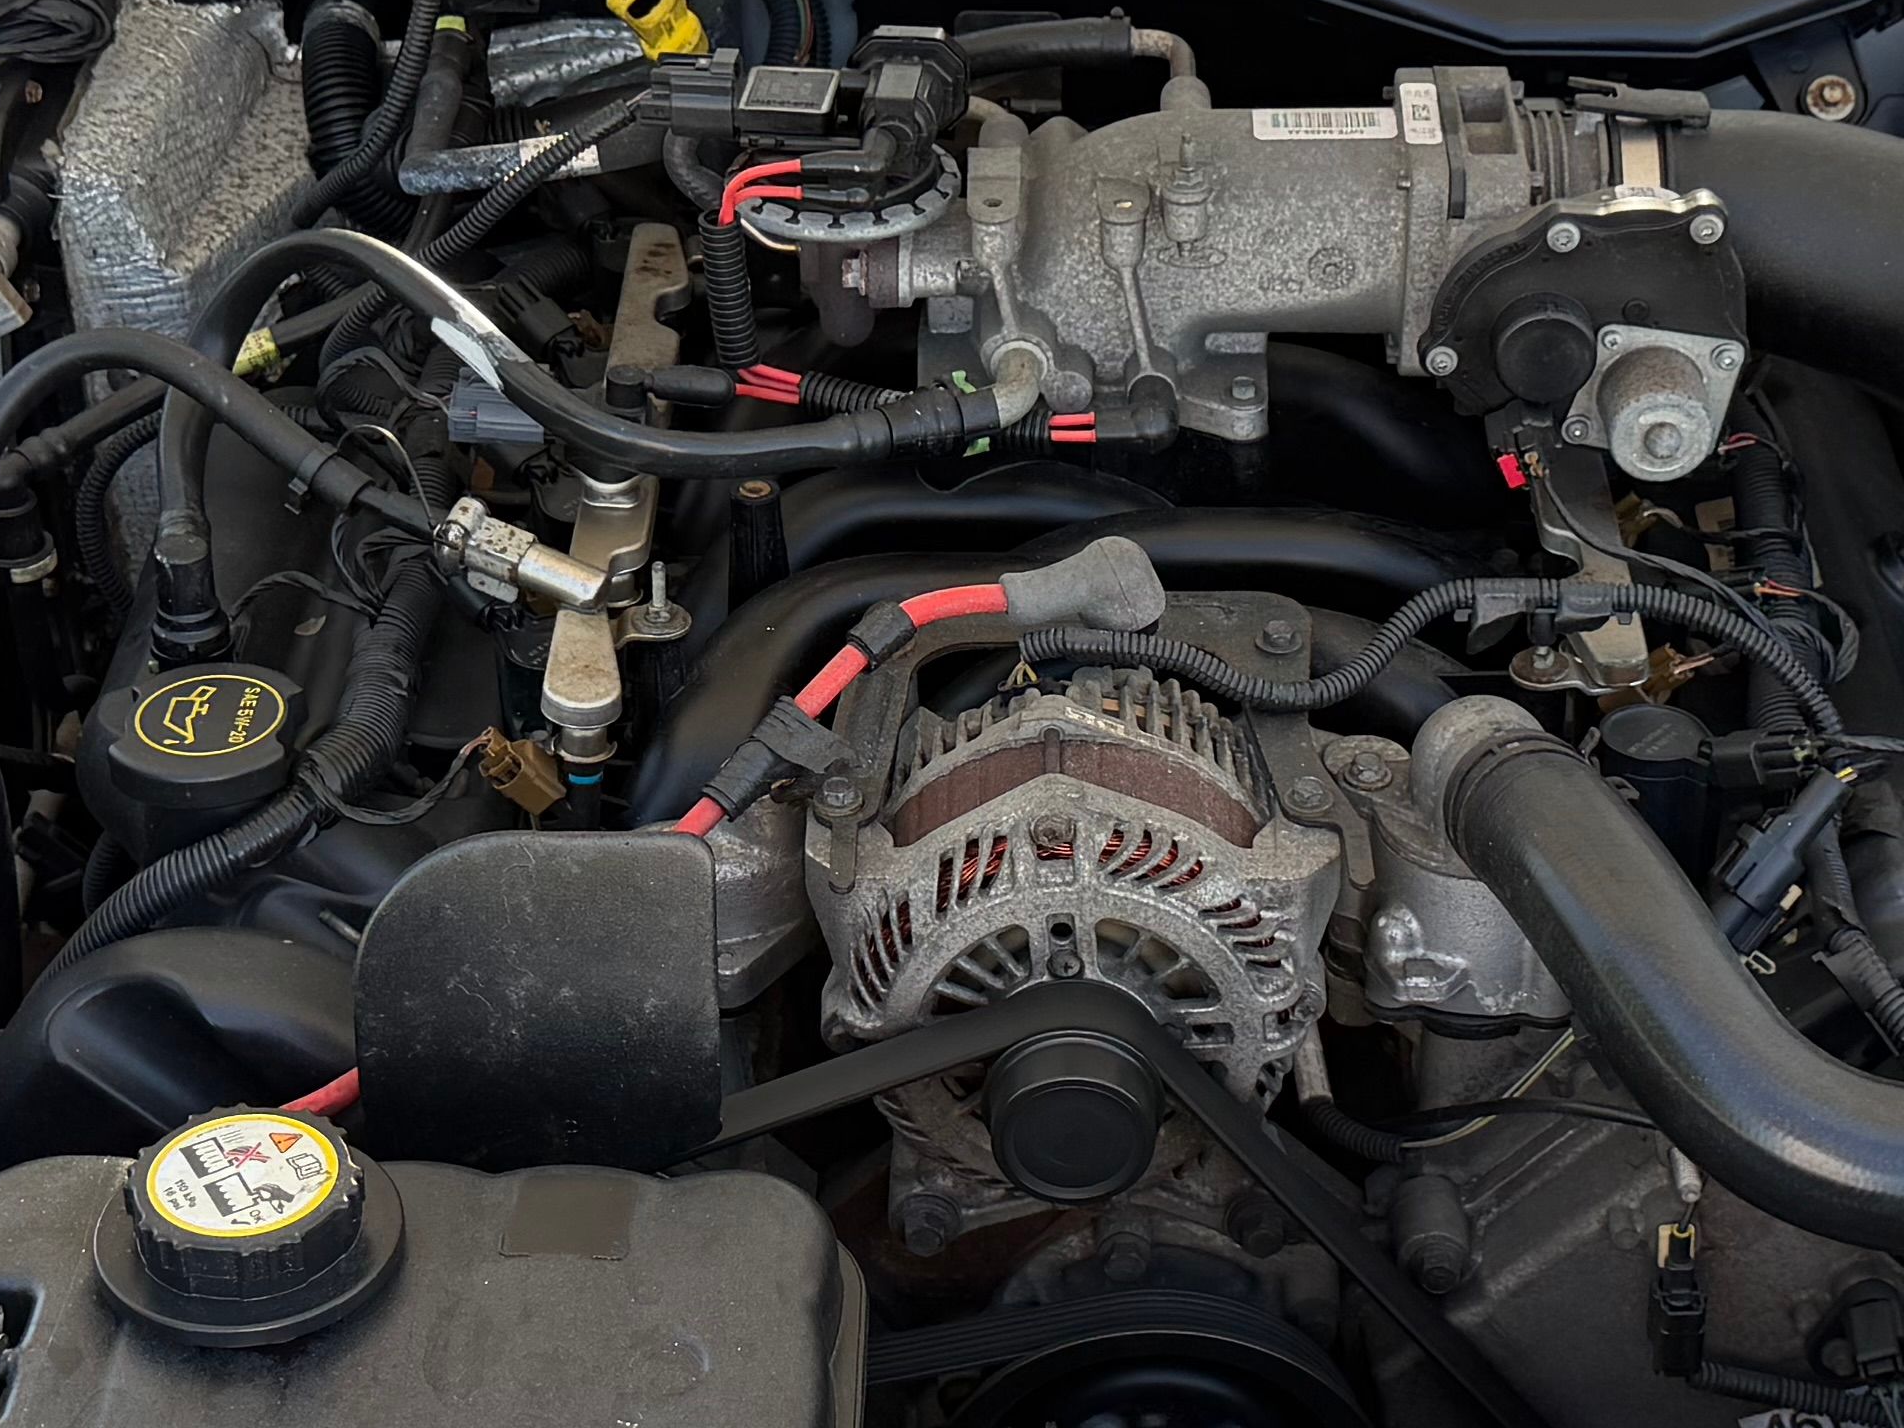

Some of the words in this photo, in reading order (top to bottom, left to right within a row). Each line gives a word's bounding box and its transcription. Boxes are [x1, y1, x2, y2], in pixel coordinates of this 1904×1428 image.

[240, 687, 261, 706] SAE
[228, 710, 254, 743] 5W-20
[250, 1210, 266, 1224] OK
